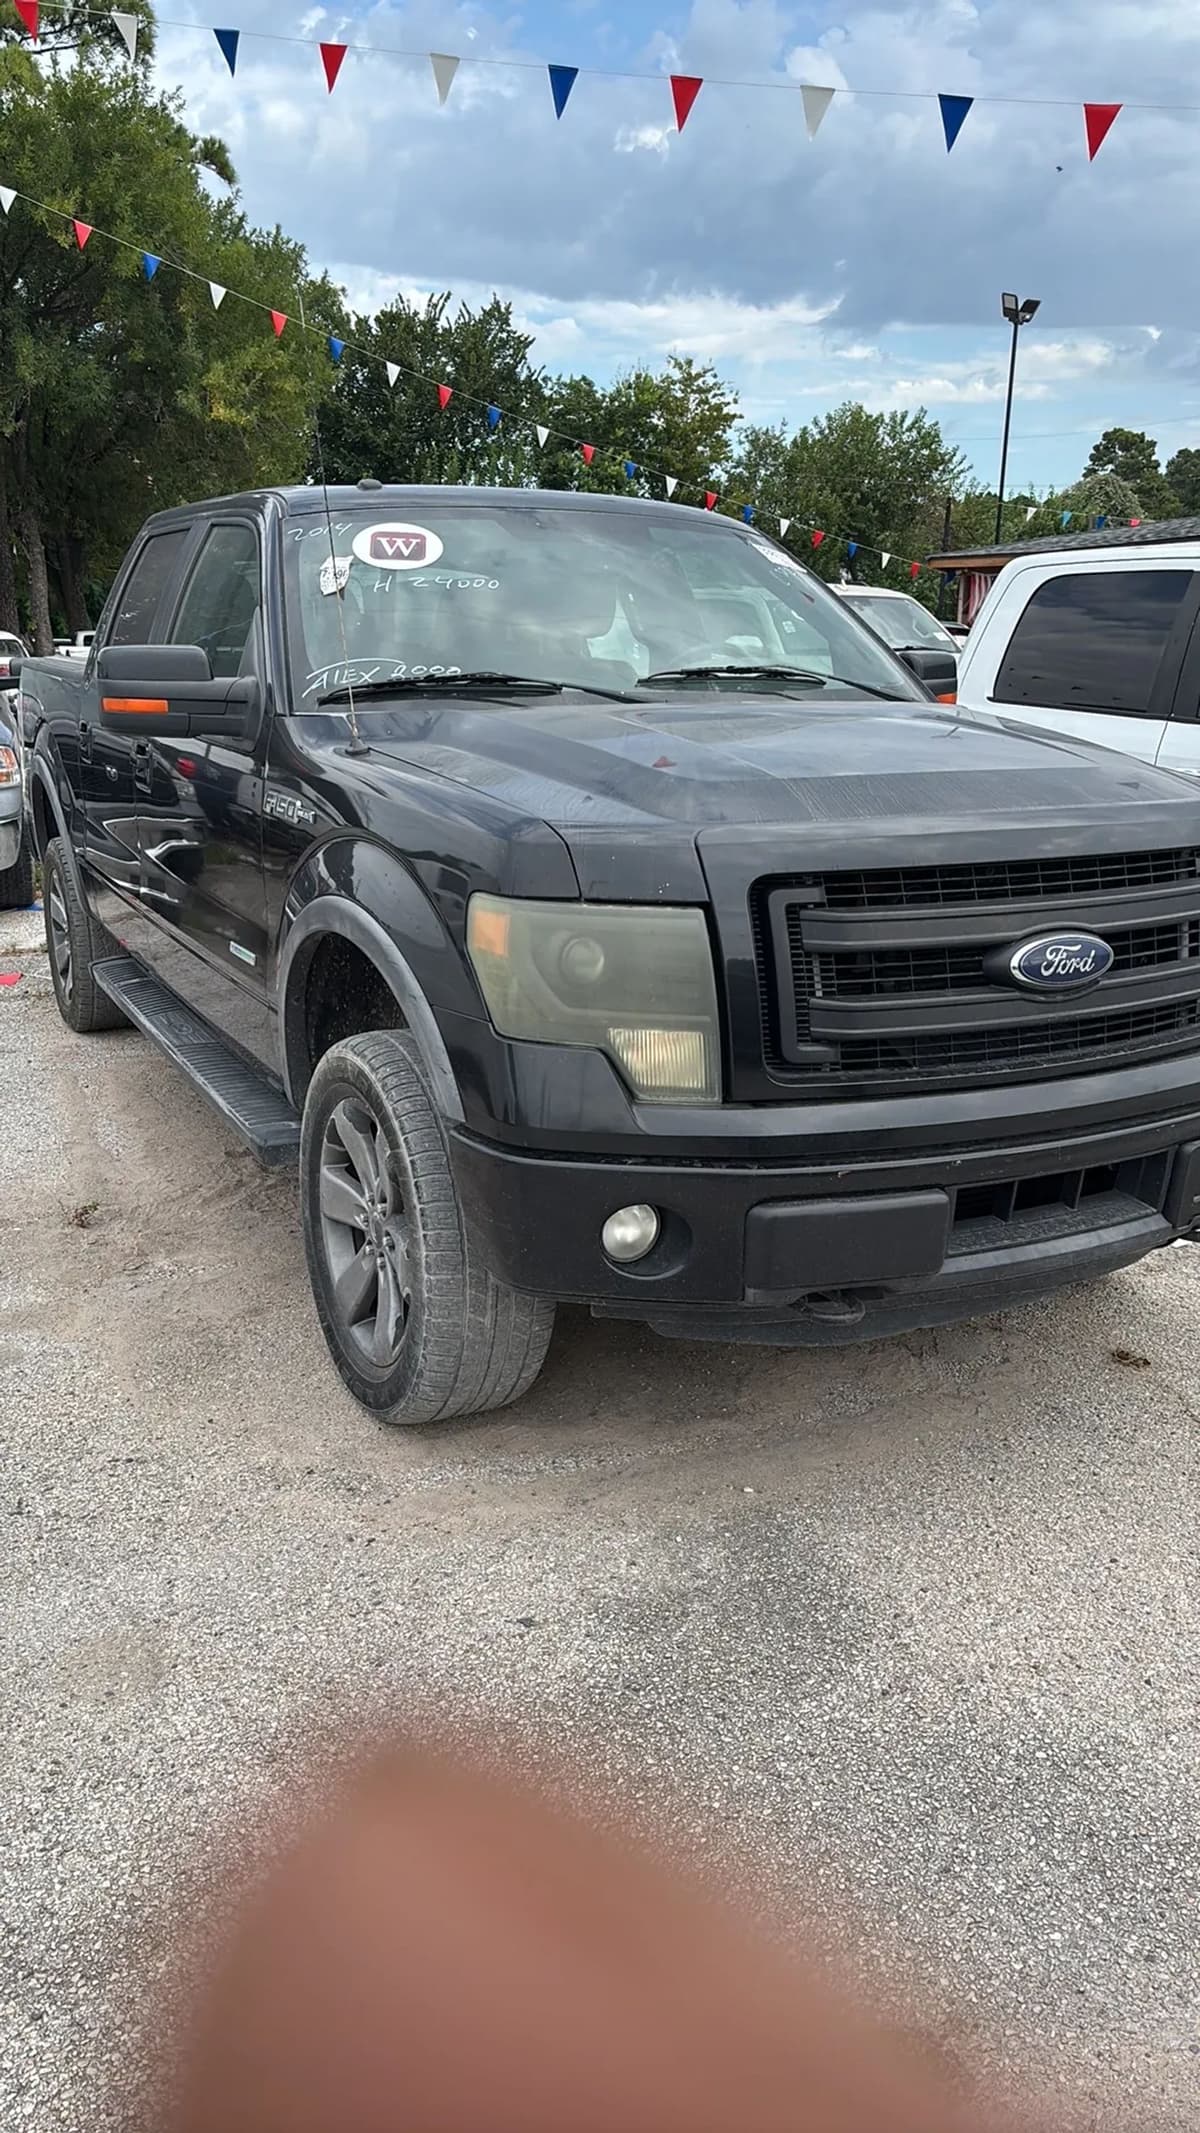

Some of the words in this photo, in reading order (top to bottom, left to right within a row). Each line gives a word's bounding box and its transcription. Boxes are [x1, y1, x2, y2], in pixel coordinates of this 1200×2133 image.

[287, 522, 353, 541] 2014
[376, 537, 421, 557] W
[407, 575, 500, 590] 24000
[1041, 944, 1095, 976] Ford
